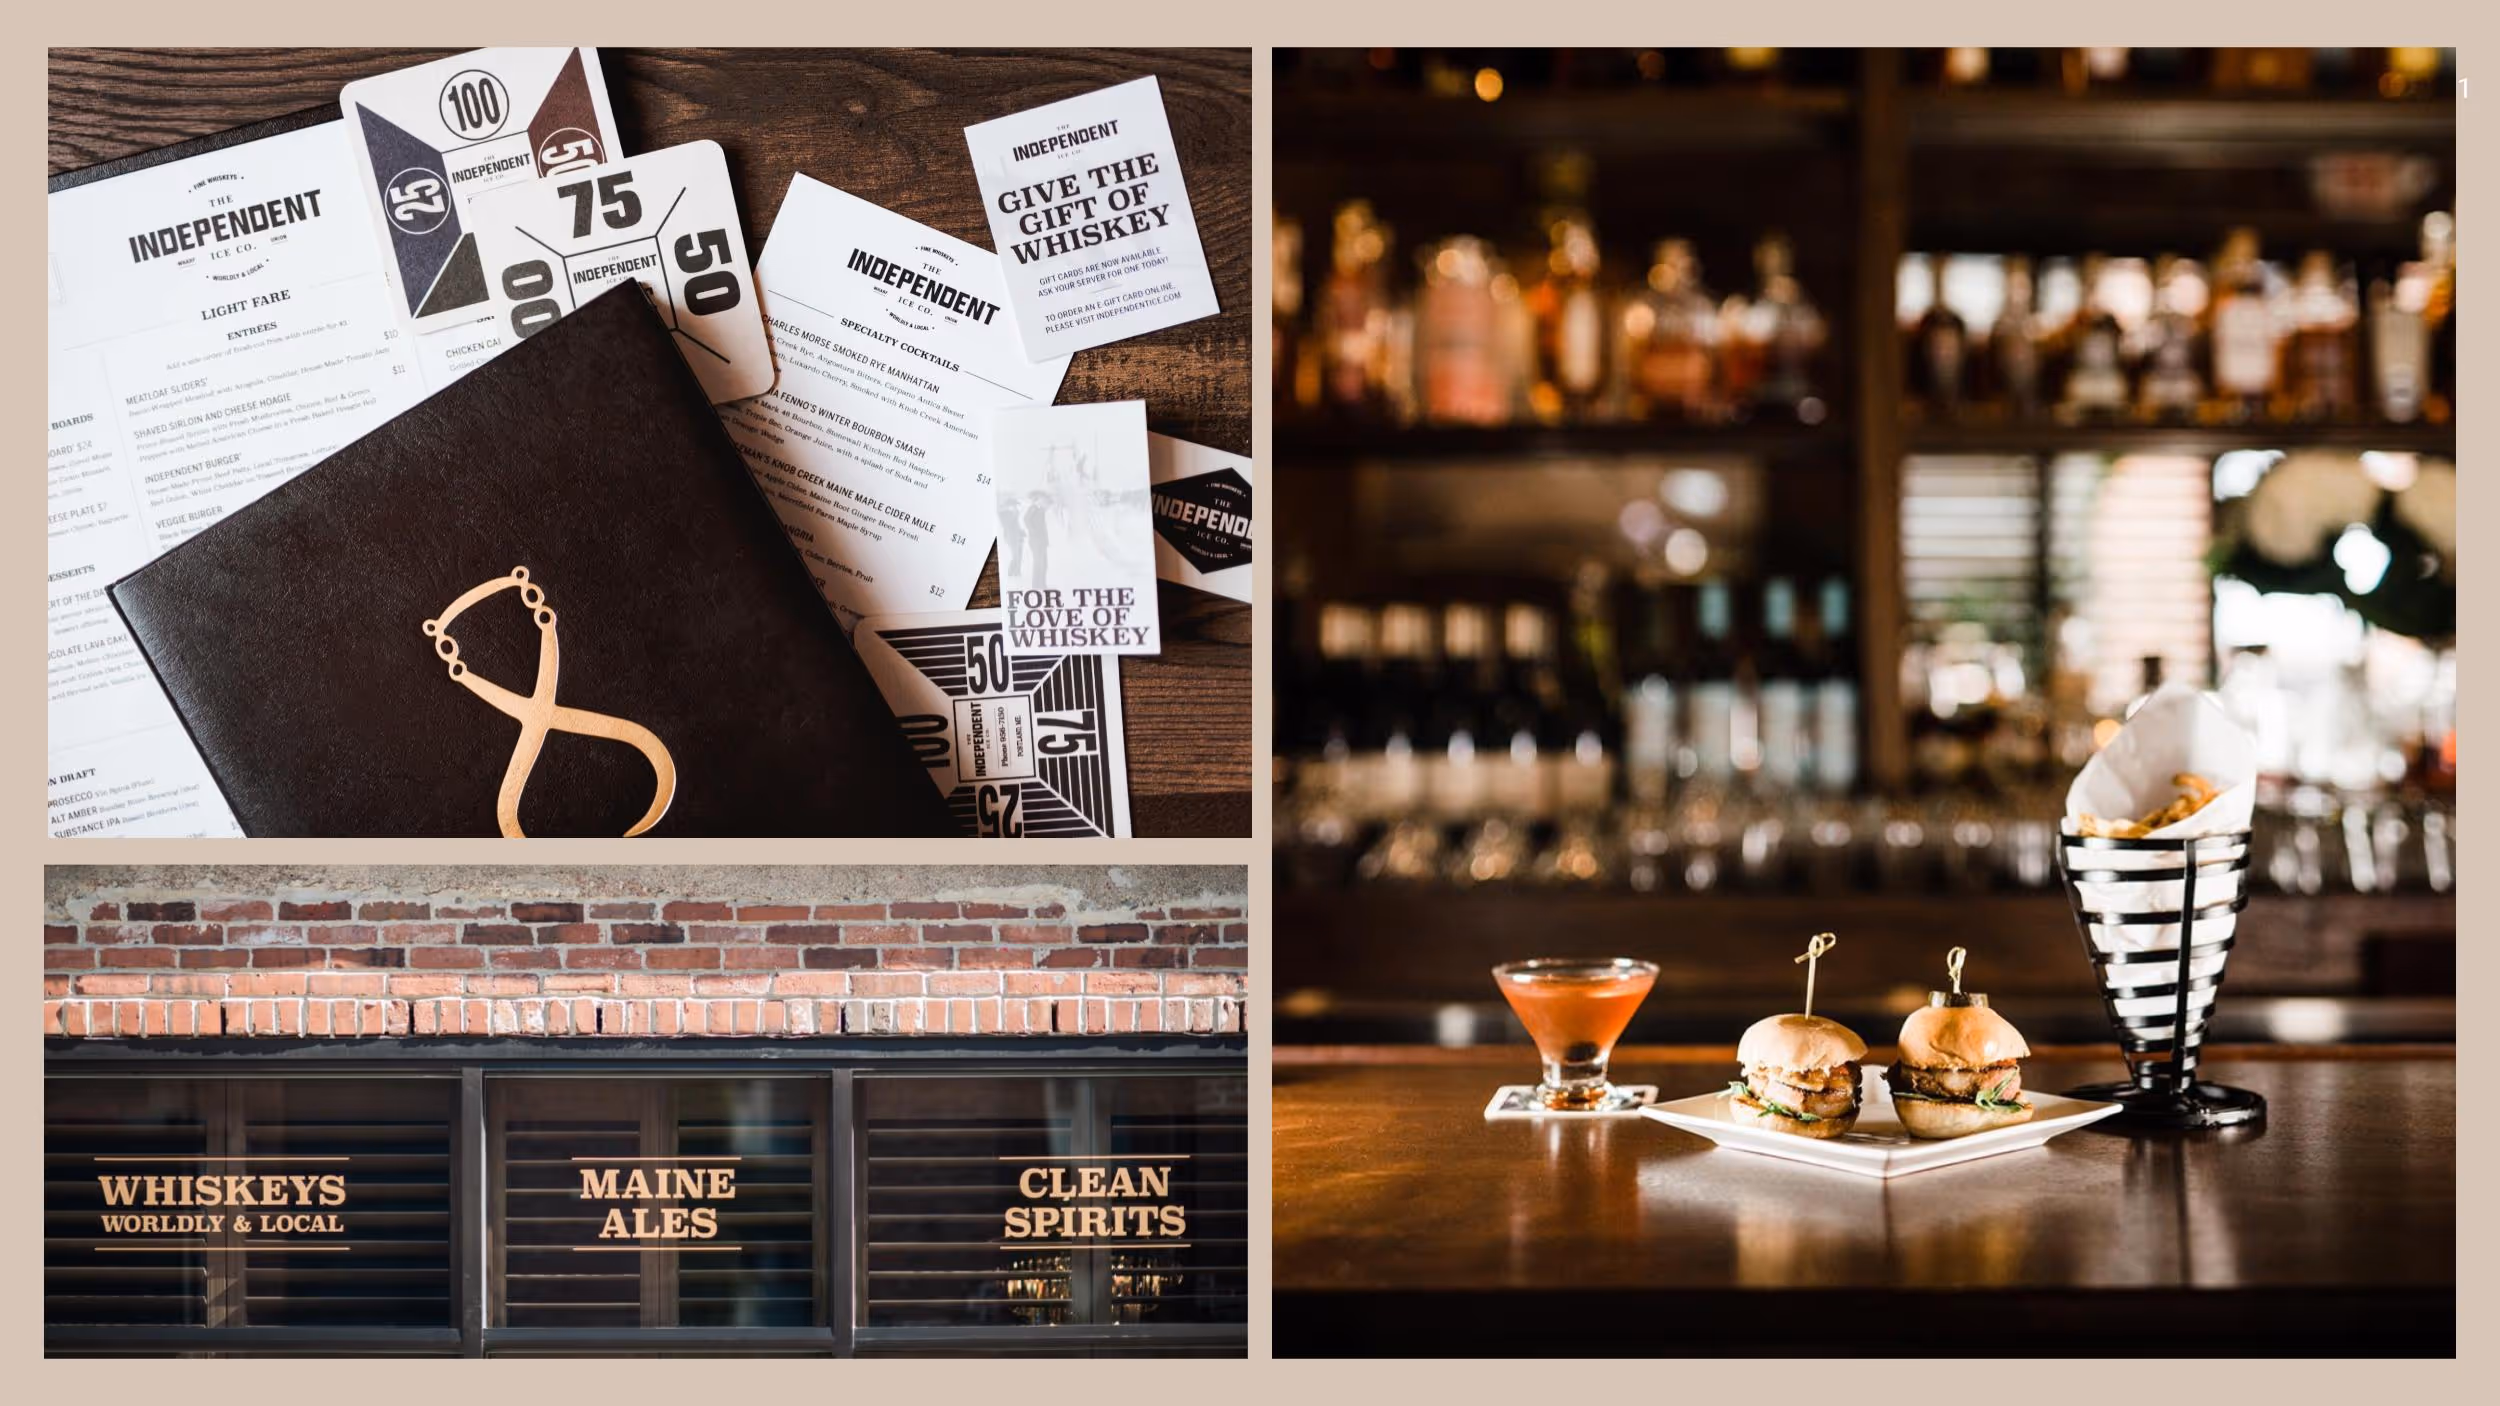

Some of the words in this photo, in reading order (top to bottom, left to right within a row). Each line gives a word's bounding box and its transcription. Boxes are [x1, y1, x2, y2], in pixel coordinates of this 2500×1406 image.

[448, 77, 501, 132] 100
[1012, 120, 1119, 162] INDEPENDENT
[452, 153, 530, 184] INDEPENDENT
[998, 174, 1081, 214] GIVE
[1088, 152, 1160, 189] THE
[208, 194, 234, 208] THE
[390, 178, 446, 221] 25
[558, 170, 642, 239] 75
[1018, 196, 1098, 236] GIFT
[1108, 182, 1150, 211] OF
[128, 189, 322, 264] INDEPENDENT
[1010, 204, 1170, 265] WHISKEY
[210, 248, 232, 260] ICE
[573, 254, 657, 284] INDEPENDENT
[922, 262, 942, 275] THE
[1039, 274, 1056, 286] GIFT
[1057, 268, 1084, 281] CARDS
[1085, 262, 1101, 274] ARE
[1101, 258, 1120, 269] NOW
[1121, 247, 1160, 264] AVAILABLE
[674, 228, 742, 316] 50
[847, 248, 1001, 325] INDEPENDENT
[1038, 287, 1054, 298] ASK
[1054, 281, 1076, 293] YOUR
[1076, 273, 1107, 287] SERVER
[1107, 268, 1123, 279] FOR
[1124, 264, 1140, 274] ONE
[1141, 256, 1168, 269] TODAY!
[201, 300, 248, 321] LIGHT
[251, 289, 291, 307] FARE
[898, 296, 913, 308] ICE
[918, 304, 933, 316] CO.
[1045, 314, 1056, 323] TO
[1057, 306, 1084, 320] ORDER
[1084, 303, 1096, 313] AN
[1122, 290, 1144, 302] CARD
[227, 320, 278, 340] ENTRÉES
[1045, 320, 1074, 334] PLEASE
[1075, 314, 1095, 326] VISIT
[446, 342, 485, 358] CHICKEN
[761, 312, 801, 337] CHARLES
[801, 330, 832, 350] MORSE
[832, 344, 869, 365] SMOKED
[869, 358, 887, 372] RYE
[887, 366, 940, 394] MANHATTAN
[840, 318, 899, 347] SPECIALTY
[900, 343, 960, 372] COCKTAILS
[126, 388, 168, 405] MEATLOAF
[52, 412, 94, 430] BOARDS
[134, 424, 168, 440] SHAVED
[169, 415, 204, 431] SIRLOIN
[205, 410, 223, 422] AND
[224, 401, 258, 417] CHEESE
[259, 393, 292, 408] HOAGIE
[780, 392, 818, 414] FENNO'S
[818, 407, 851, 428] WINTER
[851, 421, 894, 445] BOURBON
[894, 440, 926, 459] SMASH
[145, 462, 203, 484] INDEPENDENT
[977, 473, 991, 486] $14
[70, 505, 96, 518] PLATE
[769, 458, 797, 476] KNOB
[796, 469, 826, 488] CREEK
[826, 481, 854, 499] MAINE
[854, 493, 885, 512] MAPLE
[884, 506, 911, 523] CIDER
[911, 516, 936, 534] MULE
[1215, 498, 1232, 508] THE
[156, 514, 187, 529] VEGGIE
[188, 506, 223, 521] BURGER
[951, 533, 966, 546] $14
[48, 564, 95, 582] ESSERTS
[75, 592, 91, 603] THE
[929, 585, 945, 598] $12
[1007, 589, 1064, 609] FOR
[1072, 587, 1136, 607] THE
[1008, 608, 1084, 628] LOVE
[1093, 607, 1131, 627] OF
[85, 639, 105, 651] LAVA
[1008, 626, 1150, 649] WHISKEY
[966, 634, 1009, 694] 50
[970, 702, 986, 777] INDEPENDENT
[1037, 710, 1097, 755] 75
[60, 768, 96, 784] DRAFT
[51, 815, 65, 824] ALT
[68, 806, 97, 821] AMBER
[106, 817, 121, 828] IPA
[978, 784, 1022, 838] 25
[98, 1174, 346, 1207] WHISKEYS
[579, 1168, 736, 1200] MAINE
[1019, 1167, 1171, 1199] CLEAN
[101, 1215, 226, 1234] WORLDLY
[232, 1215, 252, 1233] &
[260, 1214, 344, 1233] LOCAL
[598, 1208, 718, 1239] ALES
[1004, 1204, 1186, 1238] SPIRITS
